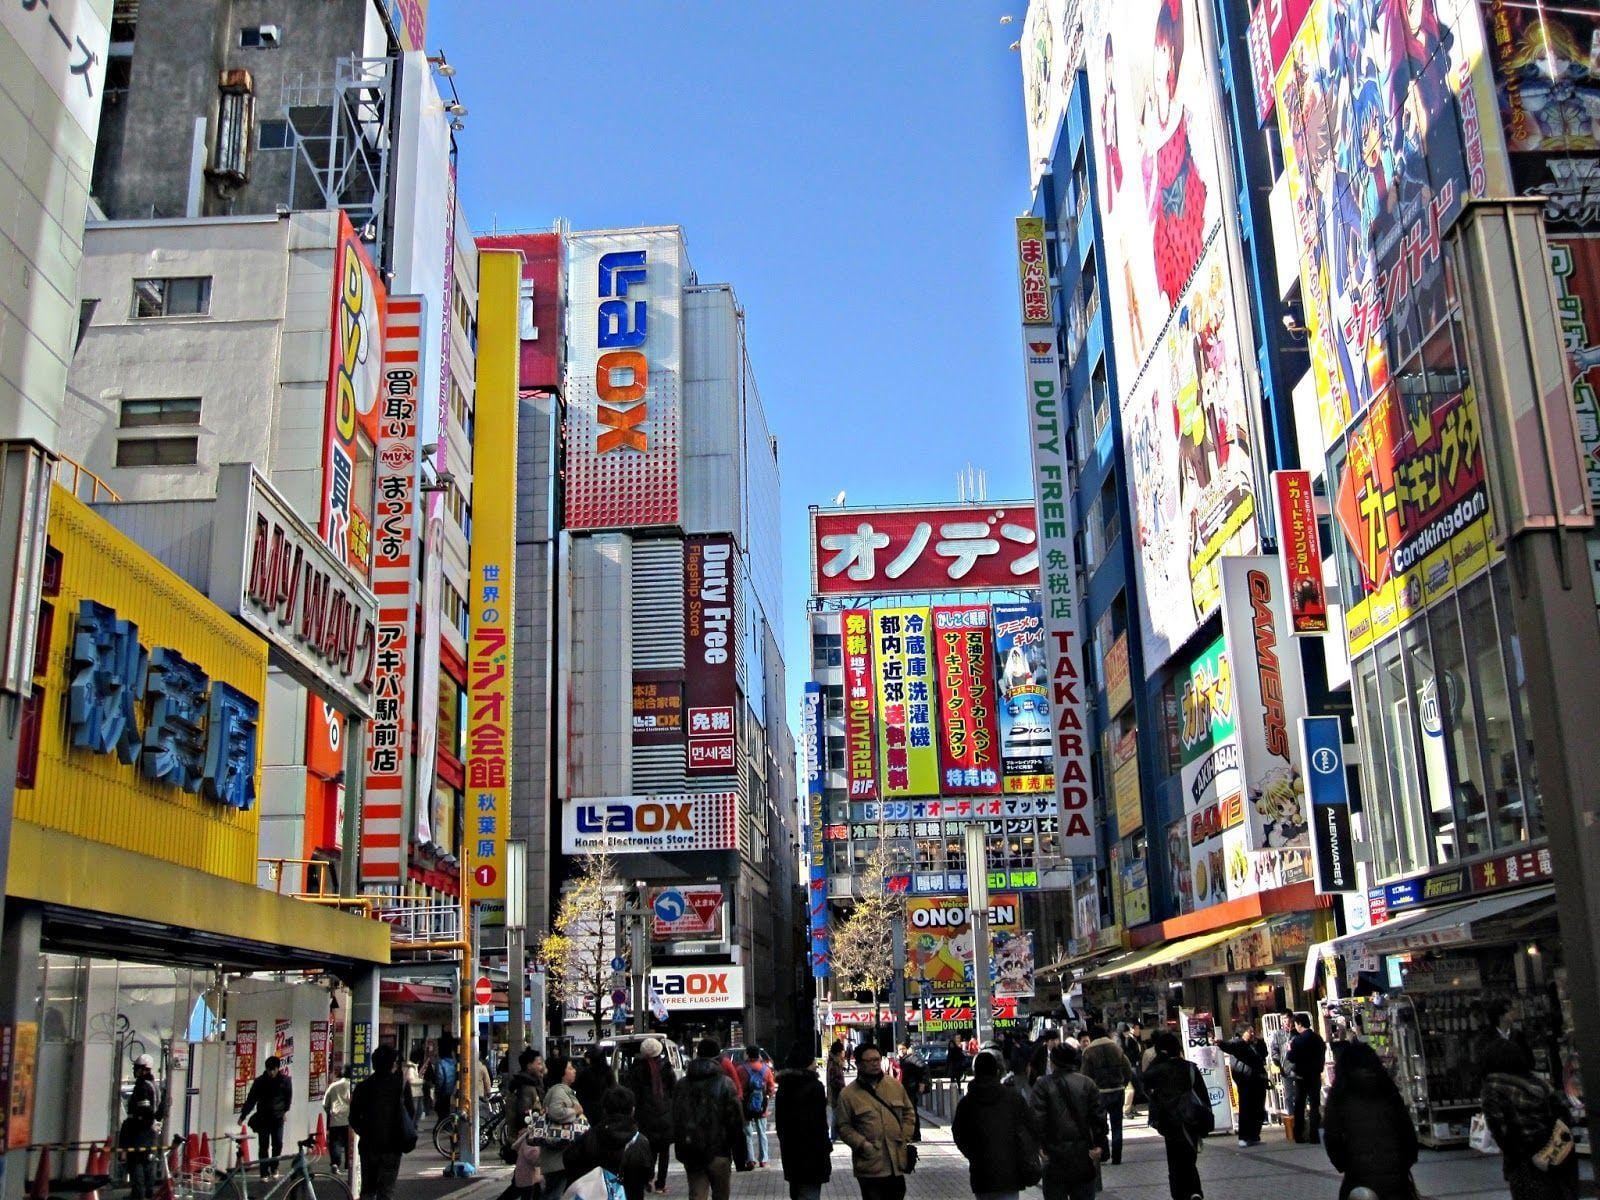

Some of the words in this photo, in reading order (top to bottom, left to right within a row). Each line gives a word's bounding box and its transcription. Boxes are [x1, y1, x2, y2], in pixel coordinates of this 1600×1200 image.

[1021, 239, 1048, 320] まんが喫茶
[336, 244, 363, 443] DVD
[385, 370, 415, 439] 買取り
[1034, 380, 1060, 455] DUTY
[1040, 465, 1066, 539] FREE
[482, 565, 500, 623] 世界の
[686, 545, 700, 598] Flagship
[701, 544, 730, 602] Duty
[1046, 549, 1071, 619] 免税店
[690, 602, 700, 638] Store
[704, 607, 731, 665] Free
[845, 614, 868, 655] 免税
[904, 614, 928, 676] 冷蔵庫
[1013, 628, 1044, 647] キレイ
[944, 632, 966, 758] サーキュレータ・コタツ
[966, 632, 989, 763] 石油ストーブ・カーペット
[1247, 568, 1291, 765] GAMERS
[372, 626, 404, 774] アキバ駅前店
[469, 628, 507, 789] ラジオ会館
[692, 712, 730, 731] 免税
[907, 682, 931, 747] 洗濯機
[1009, 727, 1051, 736] DIGA
[692, 745, 732, 761] 면세점
[805, 691, 819, 782] Panasonic
[850, 699, 872, 779] DUTYFREE
[1051, 631, 1091, 837] TAKARADA
[1321, 751, 1330, 771] DELL
[851, 779, 875, 795] B1F
[946, 769, 997, 787] 特売中
[477, 794, 496, 857] 秋葉原
[607, 836, 663, 847] Electronics
[667, 835, 694, 845] Store
[811, 793, 825, 866] ONODEN
[1327, 807, 1342, 880] ALIENWARE
[987, 873, 1006, 888] ED
[1010, 871, 1038, 887] 照明
[942, 1021, 974, 1030] ONODEN
